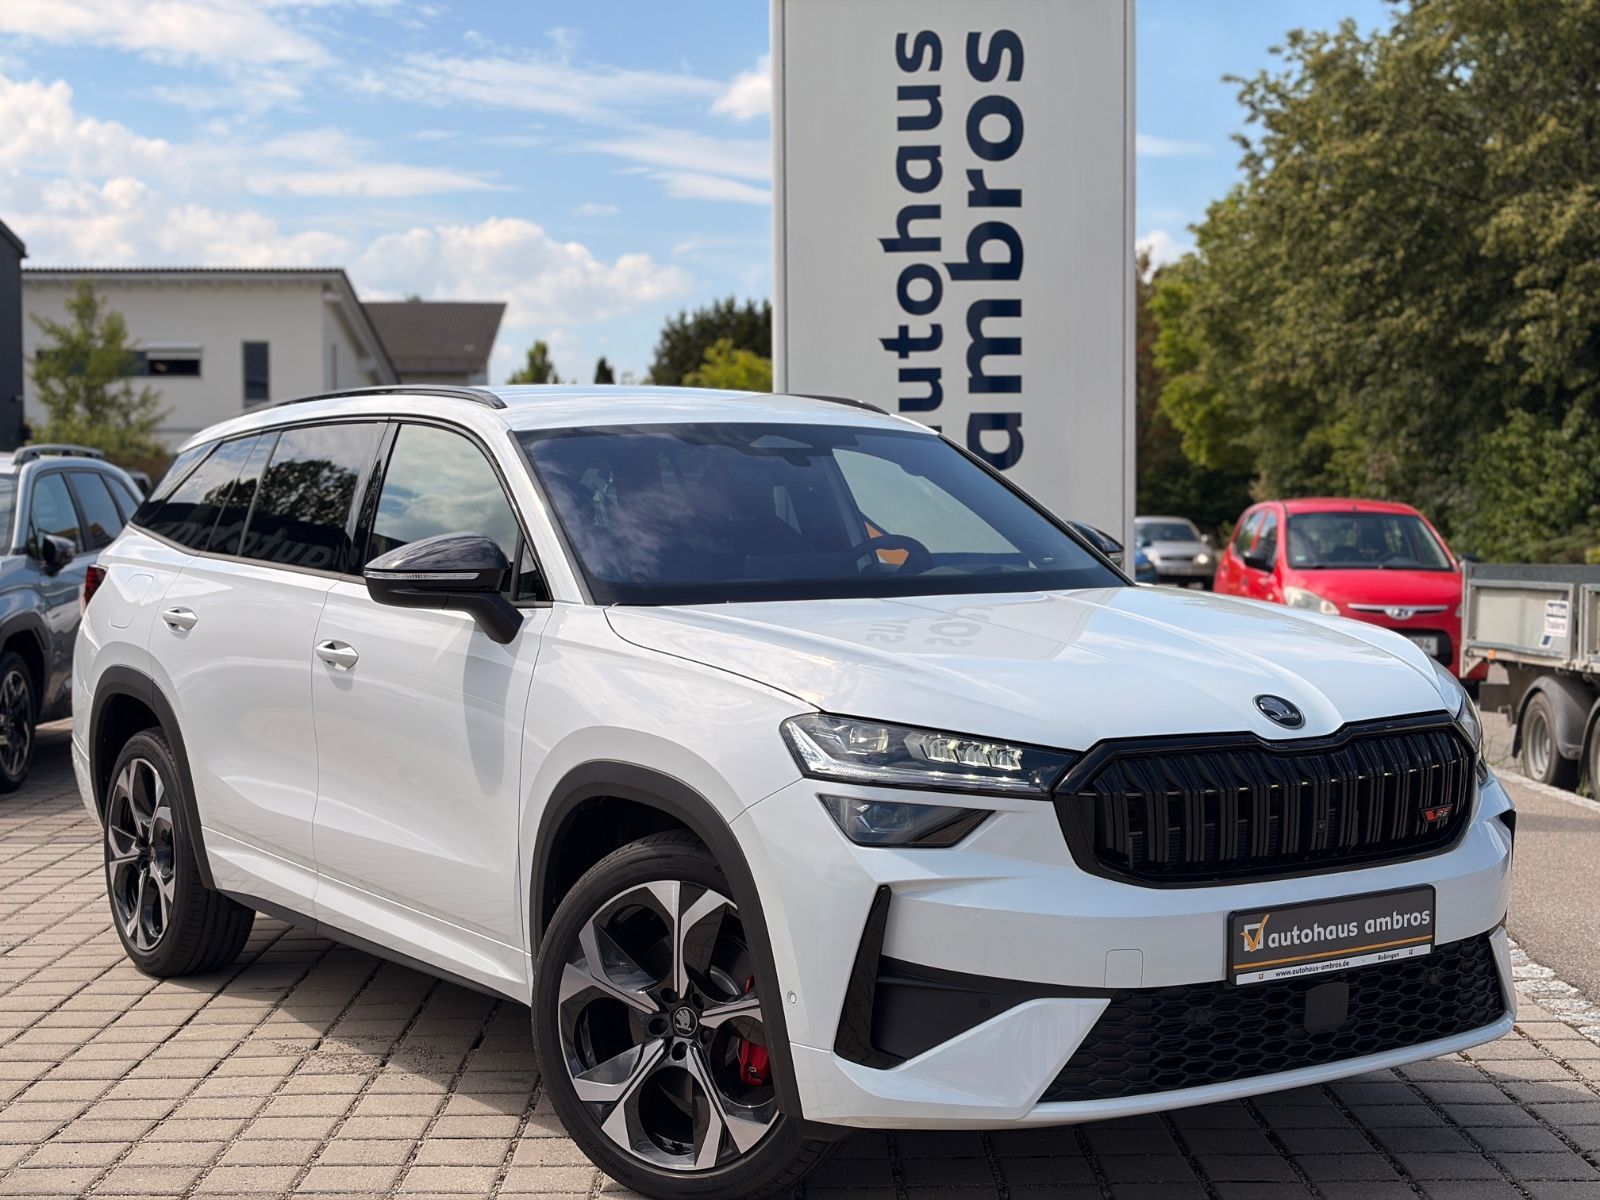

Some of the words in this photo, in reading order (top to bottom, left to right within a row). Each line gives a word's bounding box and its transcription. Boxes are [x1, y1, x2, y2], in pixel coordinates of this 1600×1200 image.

[878, 29, 943, 432] utohaus
[943, 28, 1024, 471] ambros
[1268, 921, 1358, 948] autohaus
[1364, 910, 1431, 934] ambros
[1275, 959, 1350, 977] www.autohaus-ambros.de
